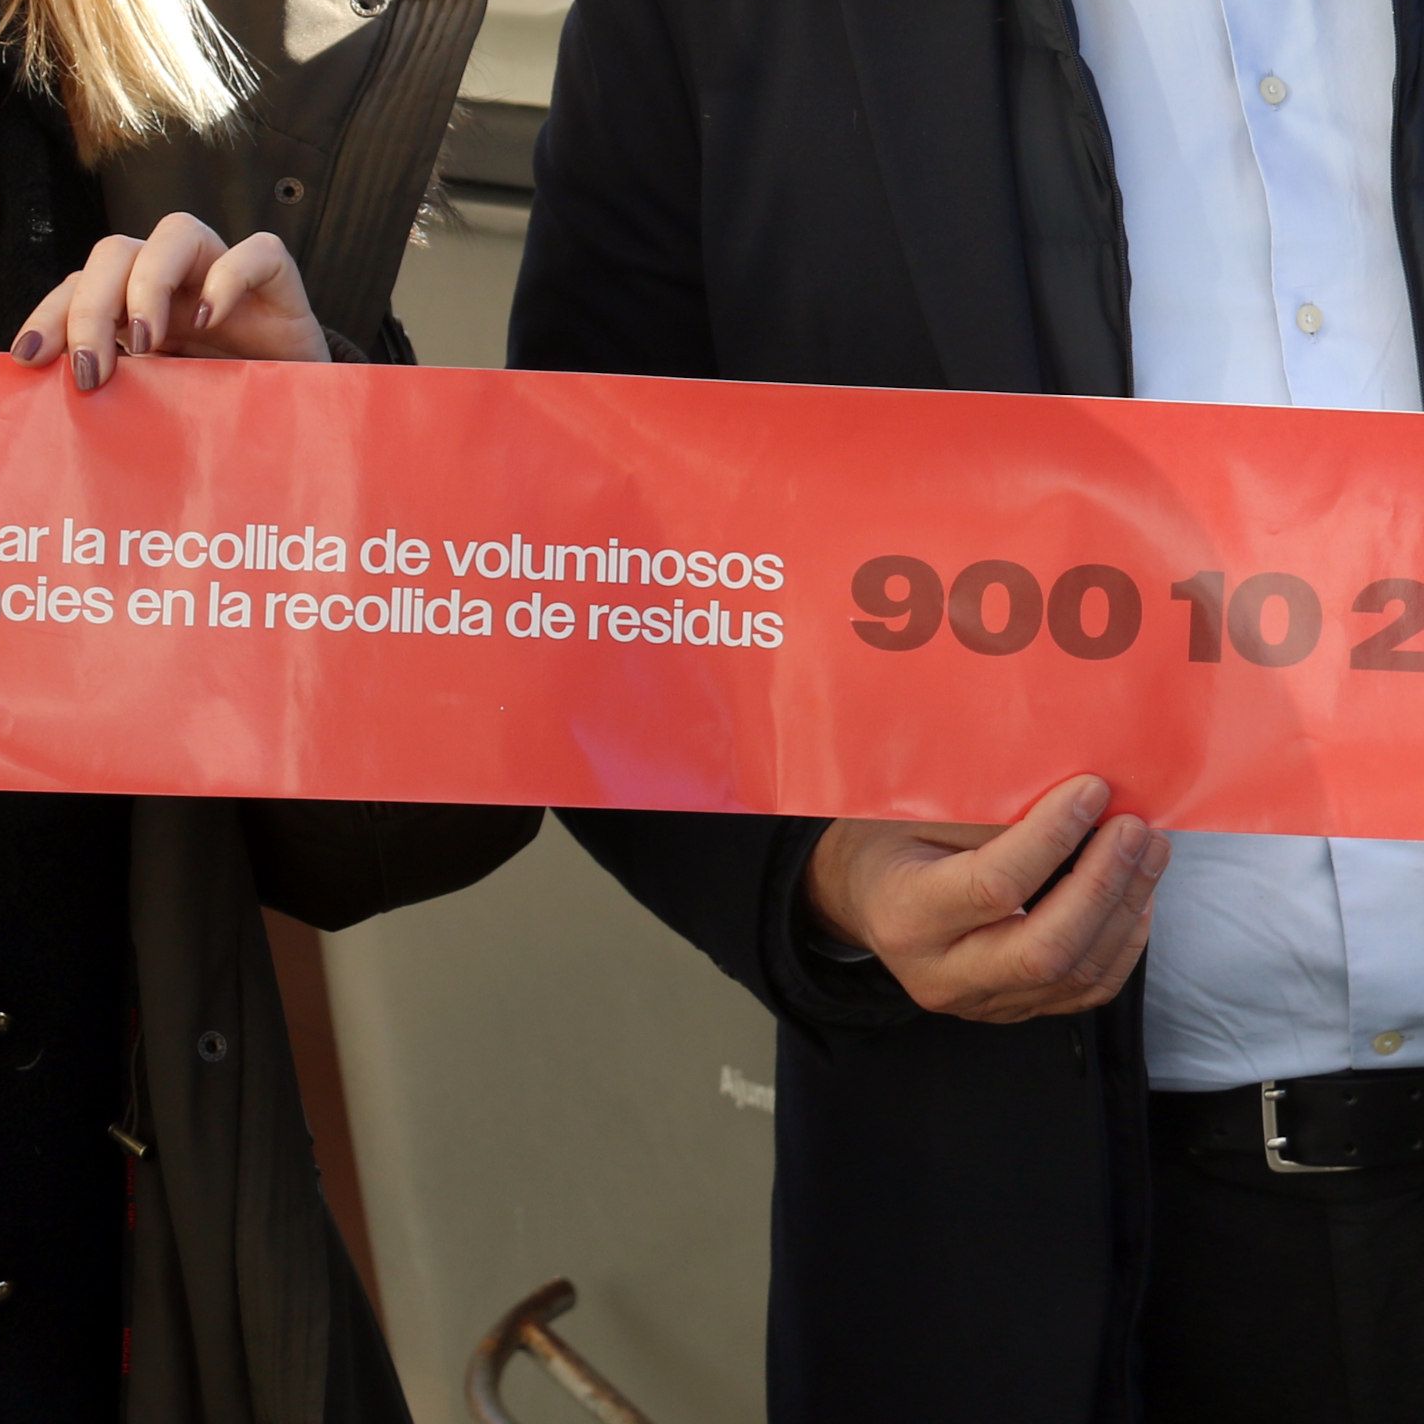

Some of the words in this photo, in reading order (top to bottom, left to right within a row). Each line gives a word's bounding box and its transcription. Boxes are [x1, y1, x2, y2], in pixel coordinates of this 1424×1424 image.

[61, 517, 106, 565] la
[117, 523, 347, 573] recollida
[359, 528, 431, 576] de
[443, 532, 785, 592] voluminosos
[126, 585, 196, 627] en
[208, 580, 251, 629] la
[264, 586, 493, 637] recollida
[504, 591, 576, 640] de
[588, 598, 785, 650] residus
[850, 554, 1144, 660] 900
[1170, 569, 1323, 668] 10
